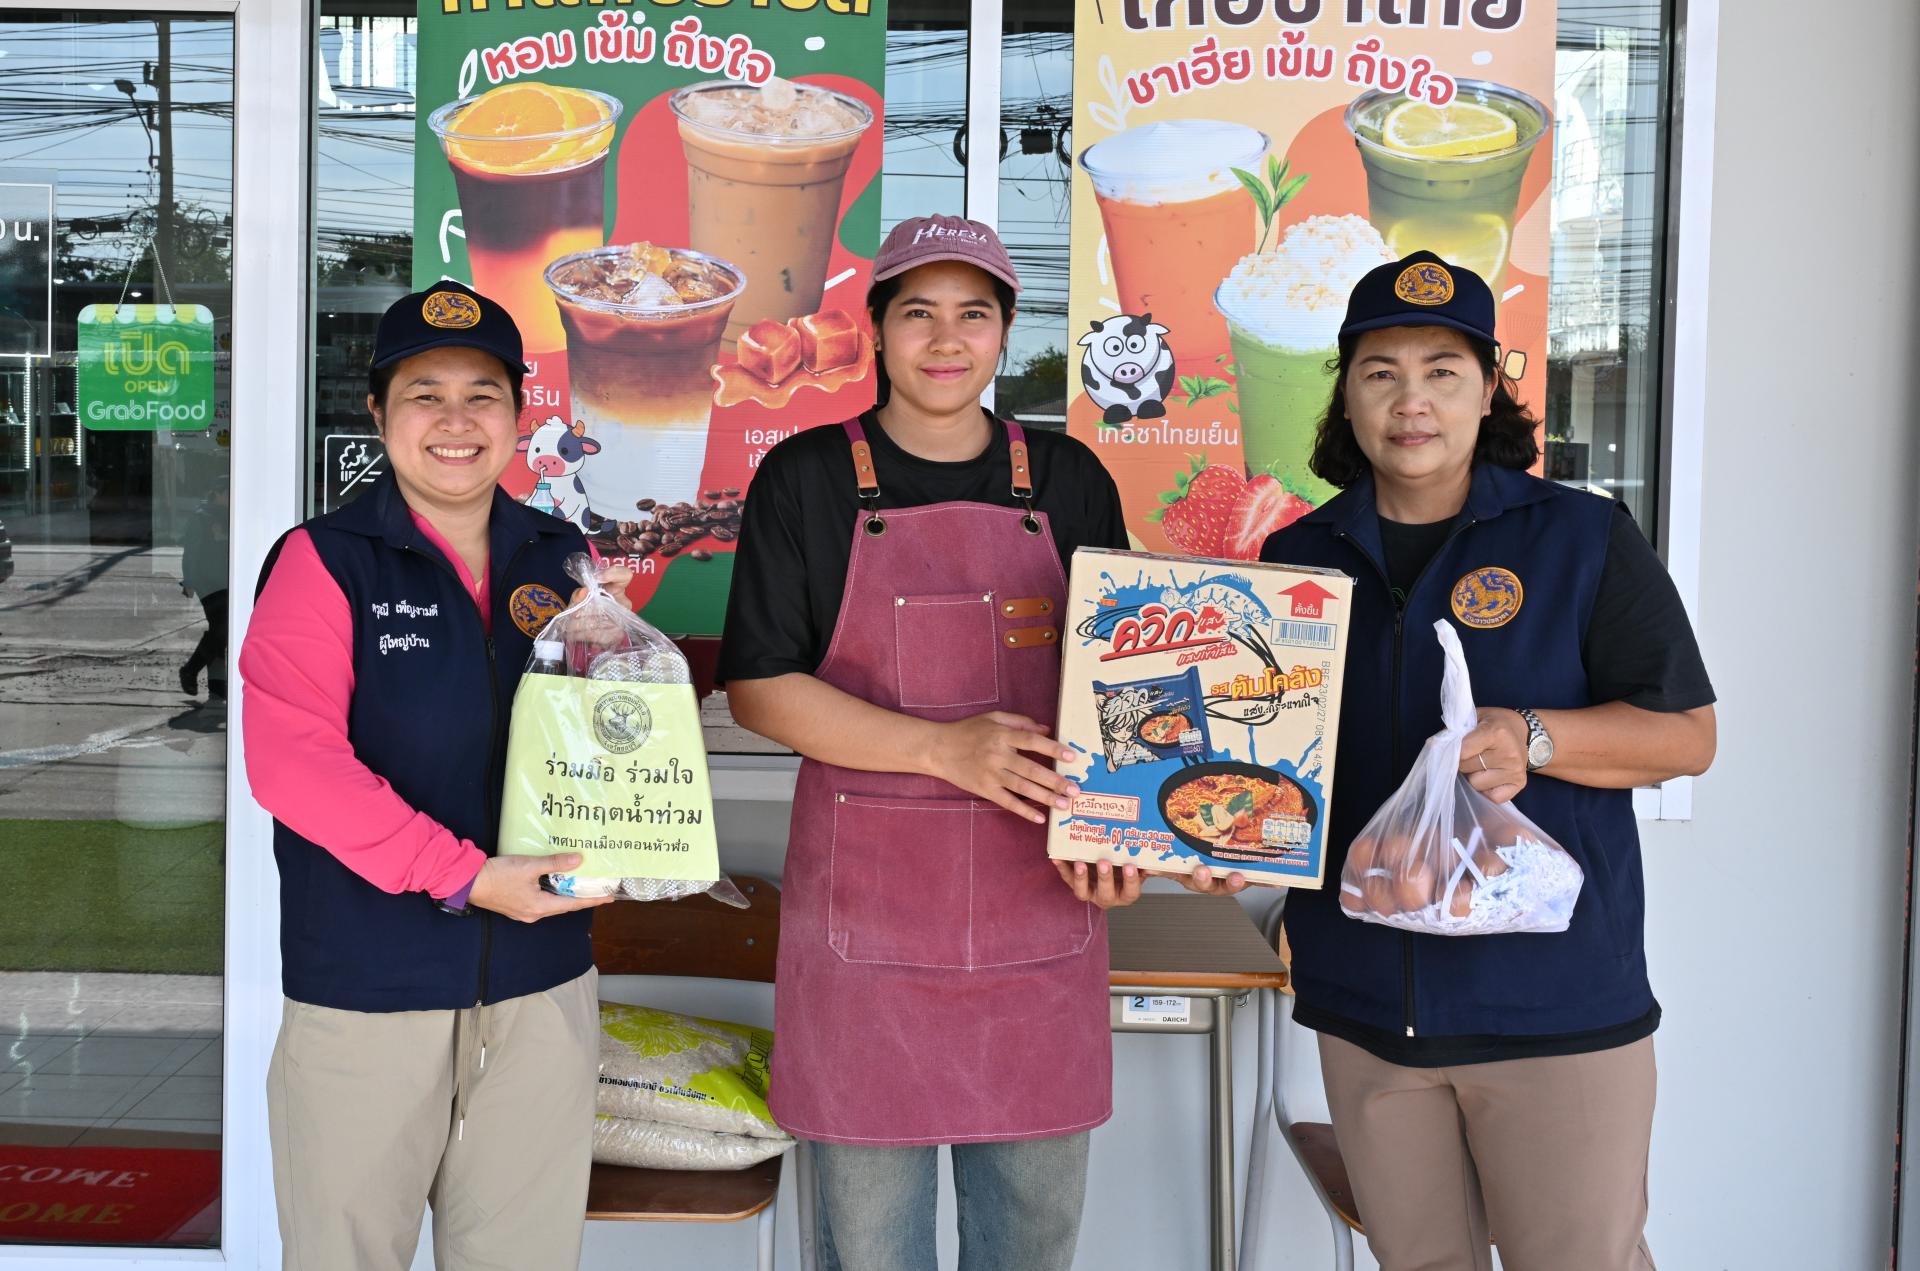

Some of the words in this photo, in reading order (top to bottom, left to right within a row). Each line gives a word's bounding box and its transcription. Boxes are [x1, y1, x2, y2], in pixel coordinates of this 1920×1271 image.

[482, 31, 574, 81] หอม
[587, 12, 653, 62] เข้ม
[666, 17, 774, 85] ถึงใจ
[1127, 37, 1251, 105] ชาเฮีย
[1266, 30, 1333, 79] เข้ม
[1347, 38, 1455, 106] ถึงใจ
[104, 330, 191, 375] เปิด
[124, 380, 169, 393] OPEN
[87, 400, 206, 421] GrabFood
[1112, 605, 1195, 652] ควิก
[379, 633, 430, 655] ผู้ใหญ่บ้าน
[1231, 665, 1322, 700] ต้มโคล้ง
[545, 752, 615, 783] ร่วมมือ
[626, 757, 694, 784] ร่วมใจ
[541, 793, 702, 826] ฝ่าวิกฤตน้ำท่วม
[1070, 833, 1082, 842] Net
[1084, 834, 1110, 845] Weight
[1111, 828, 1122, 846] 60
[1148, 830, 1158, 841] 30
[1139, 840, 1149, 849] 30
[1150, 841, 1171, 852] Bags
[1134, 996, 1145, 1008] 2
